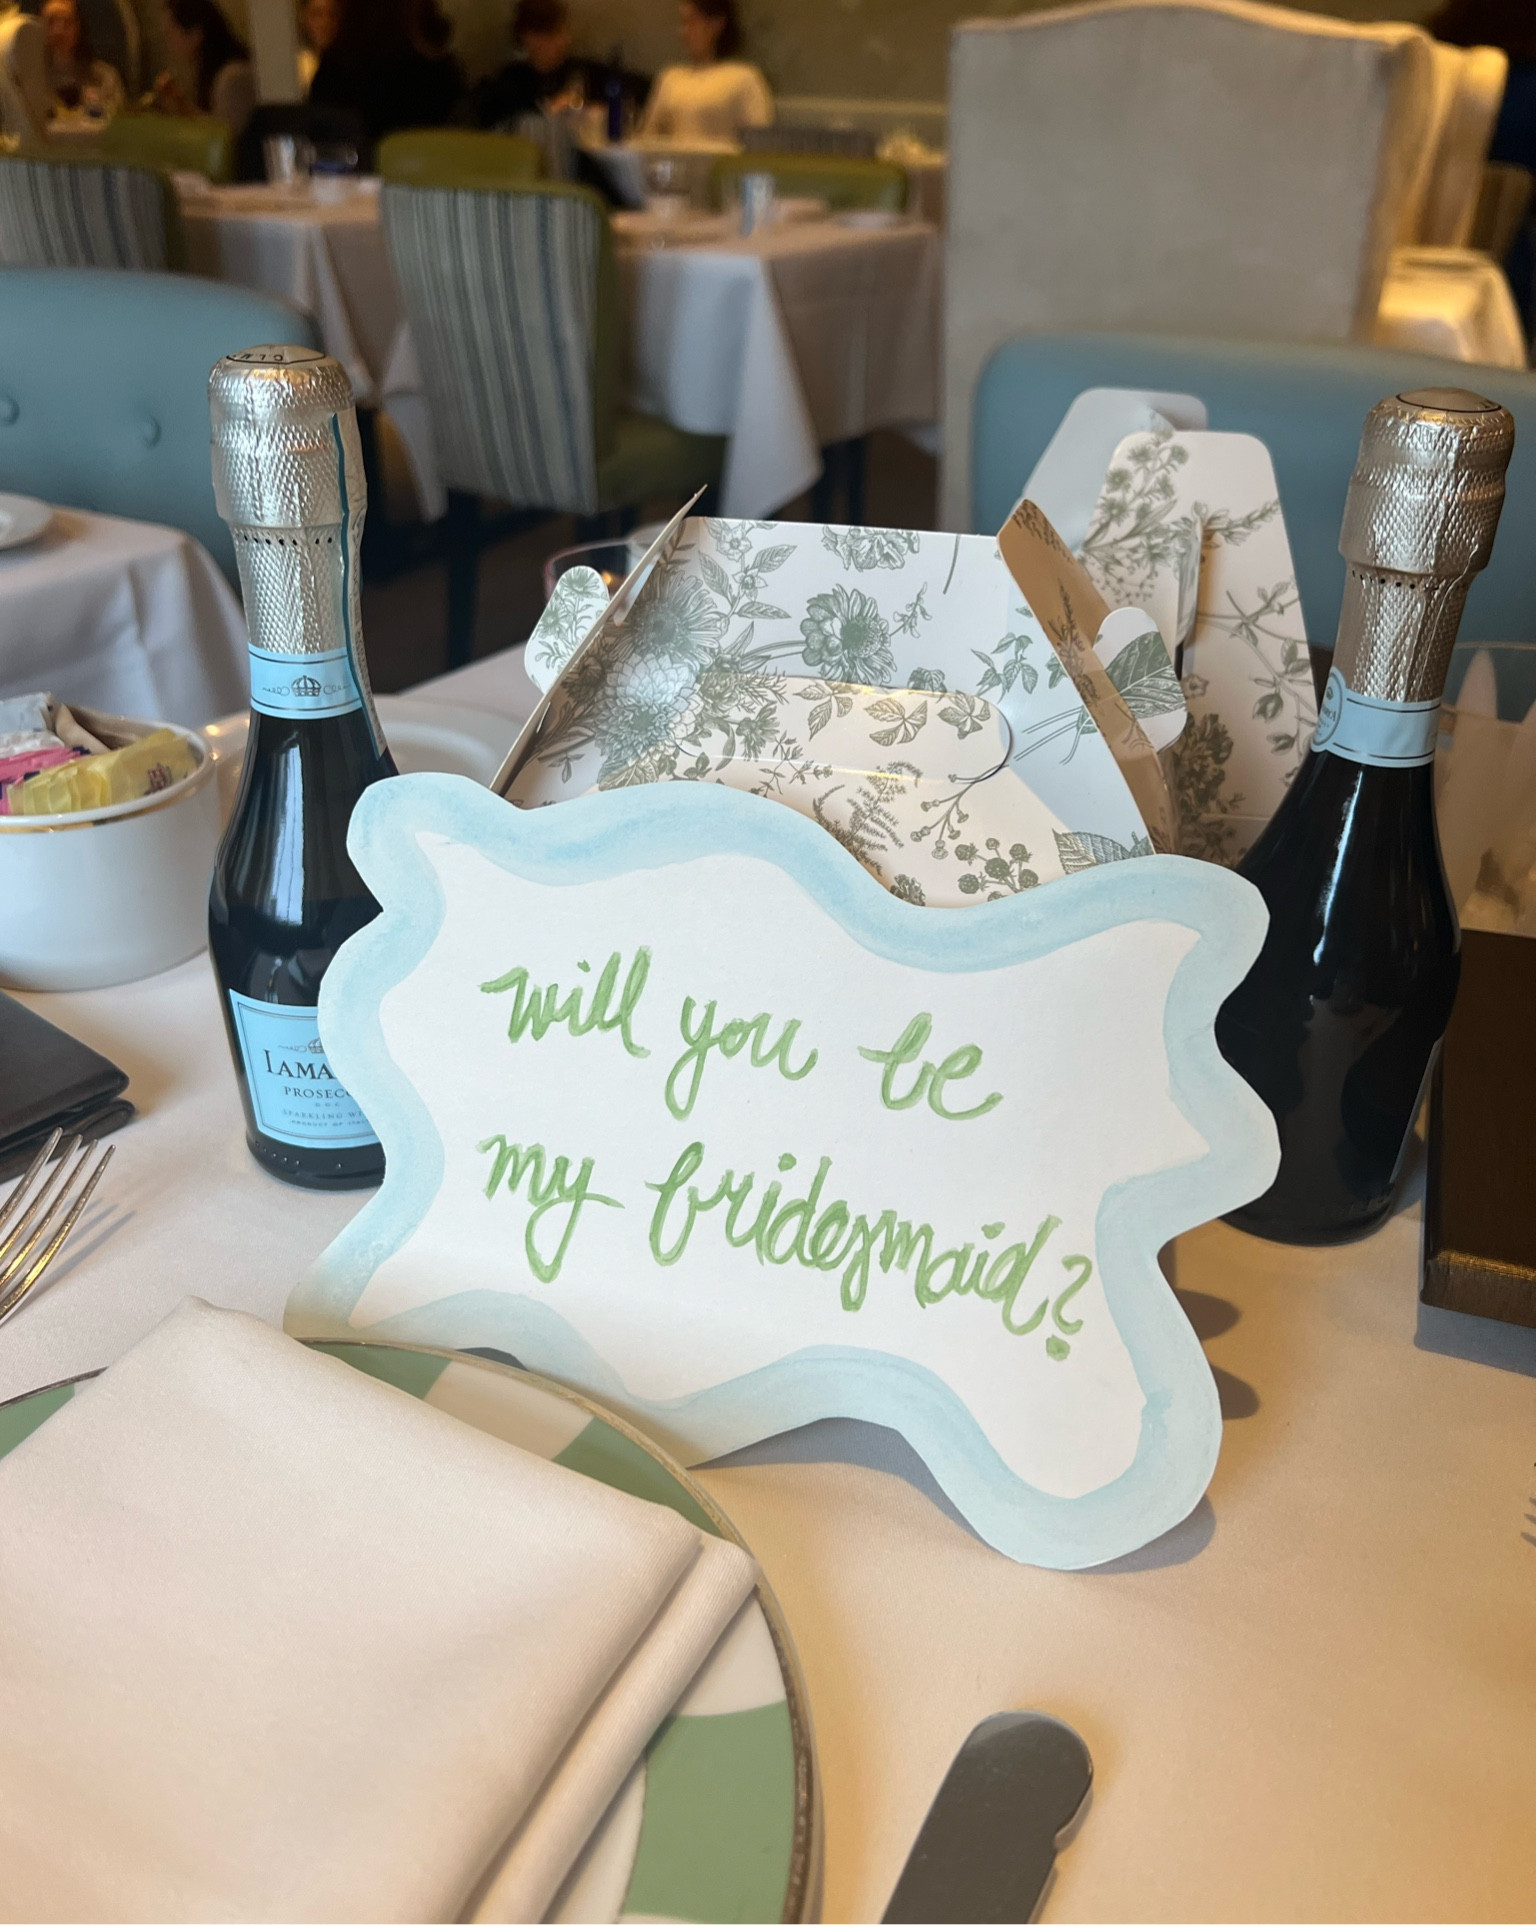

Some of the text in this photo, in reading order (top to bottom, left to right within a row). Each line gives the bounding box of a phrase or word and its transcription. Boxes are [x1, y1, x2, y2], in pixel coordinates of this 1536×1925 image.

[263, 1049, 338, 1079] LAMA
[479, 948, 1003, 1121] will you be
[284, 1086, 351, 1099] PROSEC
[479, 1135, 622, 1284] my
